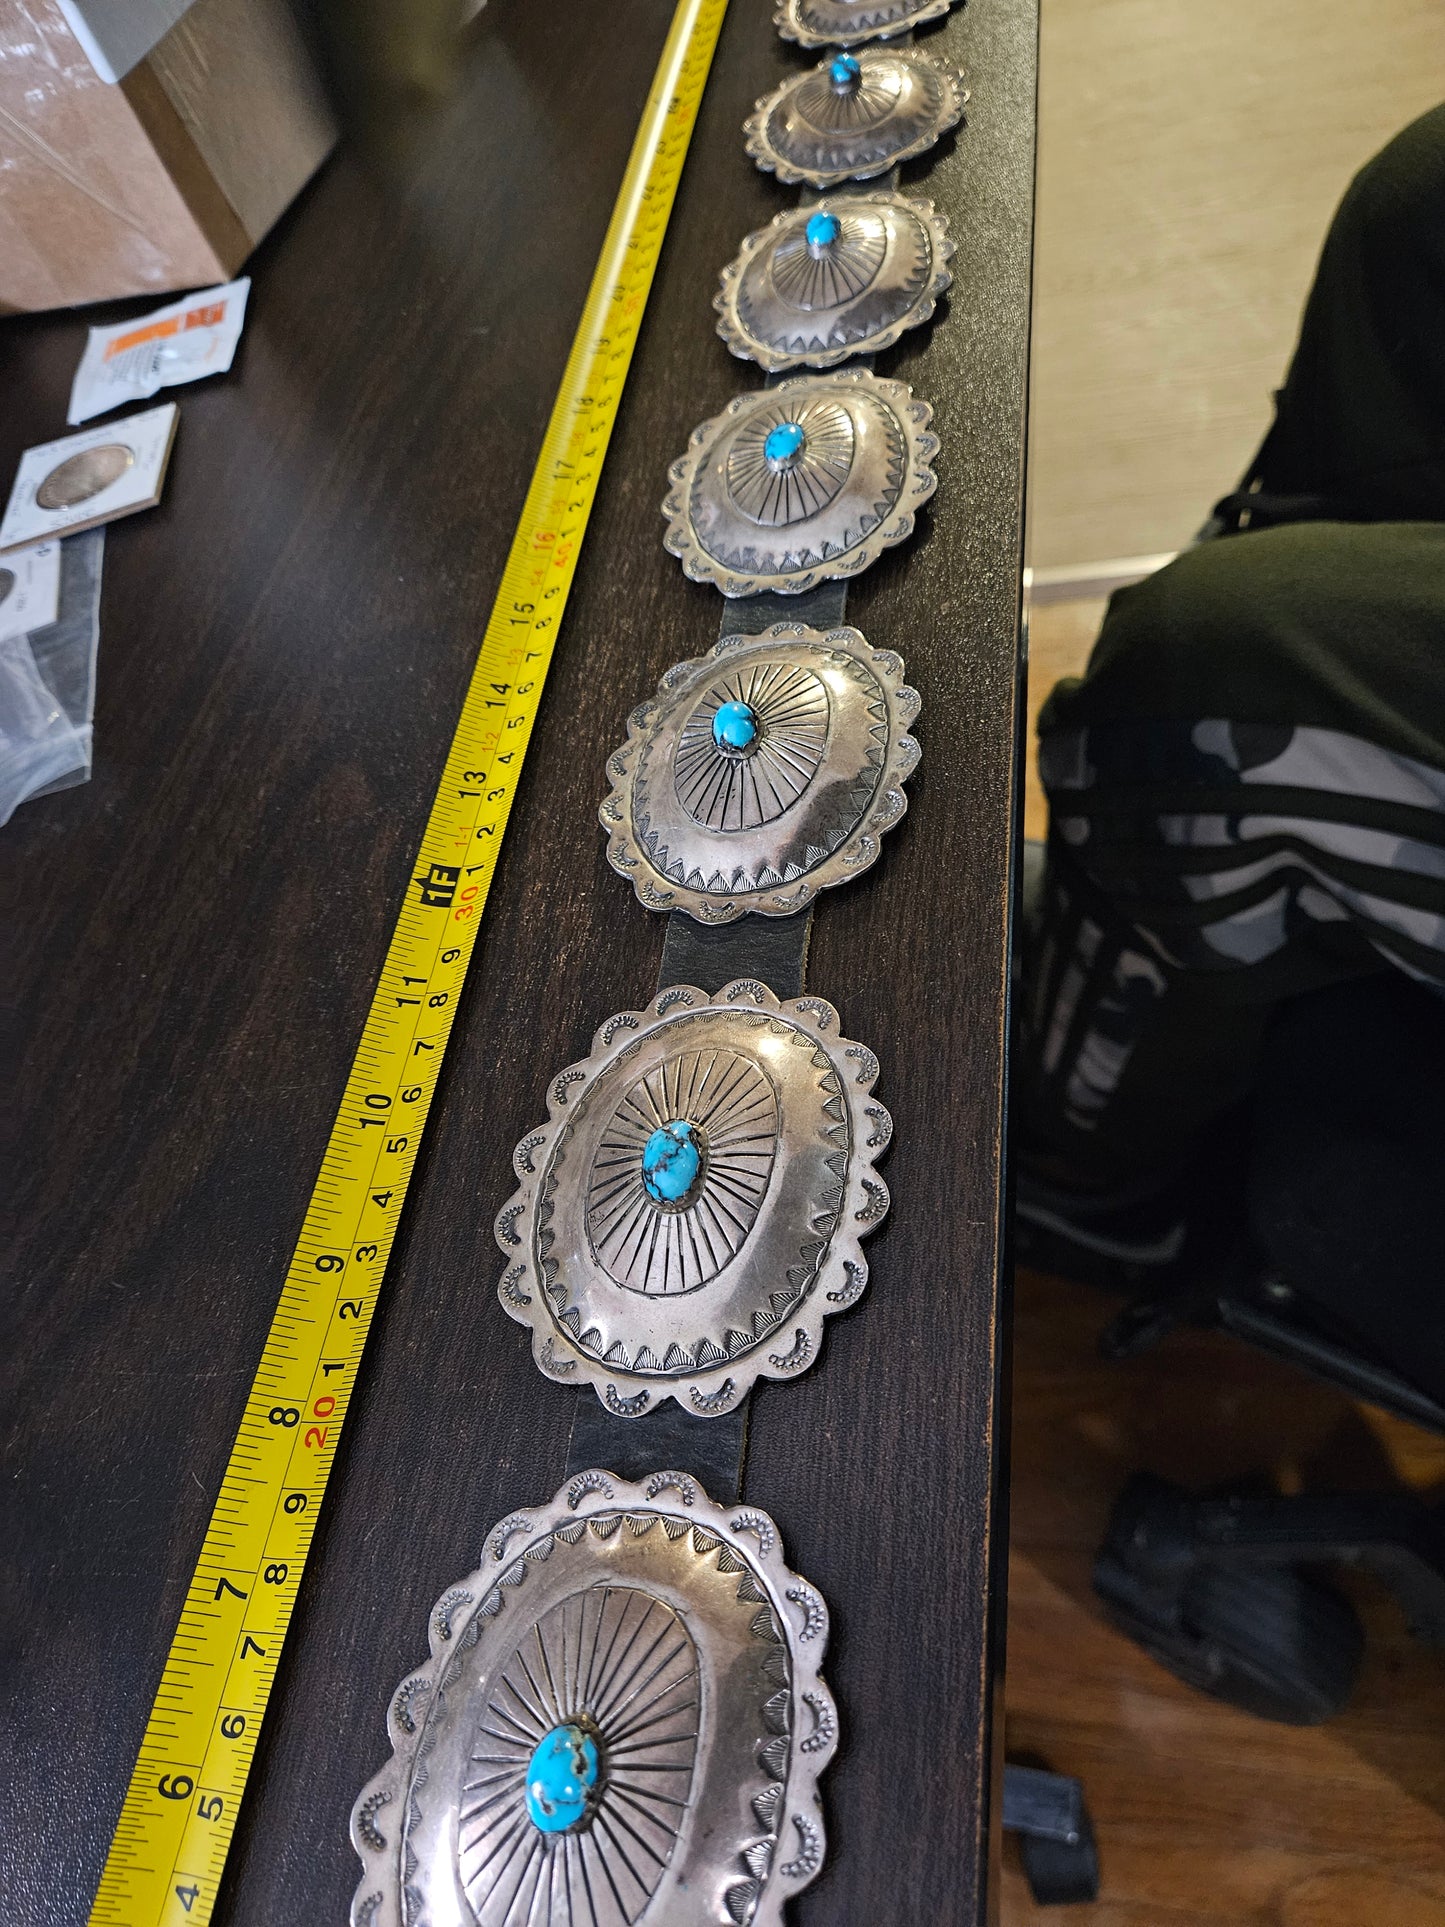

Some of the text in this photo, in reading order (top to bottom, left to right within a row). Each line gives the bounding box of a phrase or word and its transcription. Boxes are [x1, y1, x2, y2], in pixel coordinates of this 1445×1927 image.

[553, 460, 575, 480] 17
[576, 473, 591, 485] 3
[568, 500, 584, 512] 2
[533, 532, 556, 551] 16
[510, 602, 535, 627] 15
[535, 617, 552, 630] 8
[526, 652, 543, 663] 7
[485, 682, 512, 709] 14
[517, 682, 534, 694] 6
[507, 716, 525, 730] 5
[482, 732, 500, 753] 1-2
[498, 752, 515, 765] 4
[458, 770, 487, 801] 13
[487, 787, 505, 802] 3
[454, 826, 473, 848] 1-1
[476, 824, 496, 840] 2
[466, 864, 485, 877] 1
[454, 885, 479, 921] 30
[441, 948, 461, 964] 9
[395, 975, 428, 1008] 11
[428, 992, 449, 1008] 8
[413, 1041, 435, 1056] 7
[401, 1087, 423, 1103] 6
[358, 1093, 393, 1130] 10
[386, 1136, 408, 1153] 5
[371, 1190, 394, 1208] 4
[355, 1244, 377, 1263] 3
[314, 1254, 345, 1274] 9
[339, 1299, 364, 1321] 2
[322, 1362, 346, 1378] 1
[268, 1406, 301, 1429] 8
[304, 1395, 336, 1449] 20
[283, 1492, 309, 1515] 9
[264, 1562, 289, 1587] 8
[214, 1577, 249, 1602] 7
[240, 1636, 267, 1662] 7
[221, 1714, 246, 1740] 6
[158, 1773, 194, 1801] 6
[197, 1795, 223, 1822] 5
[175, 1884, 201, 1913] 4
